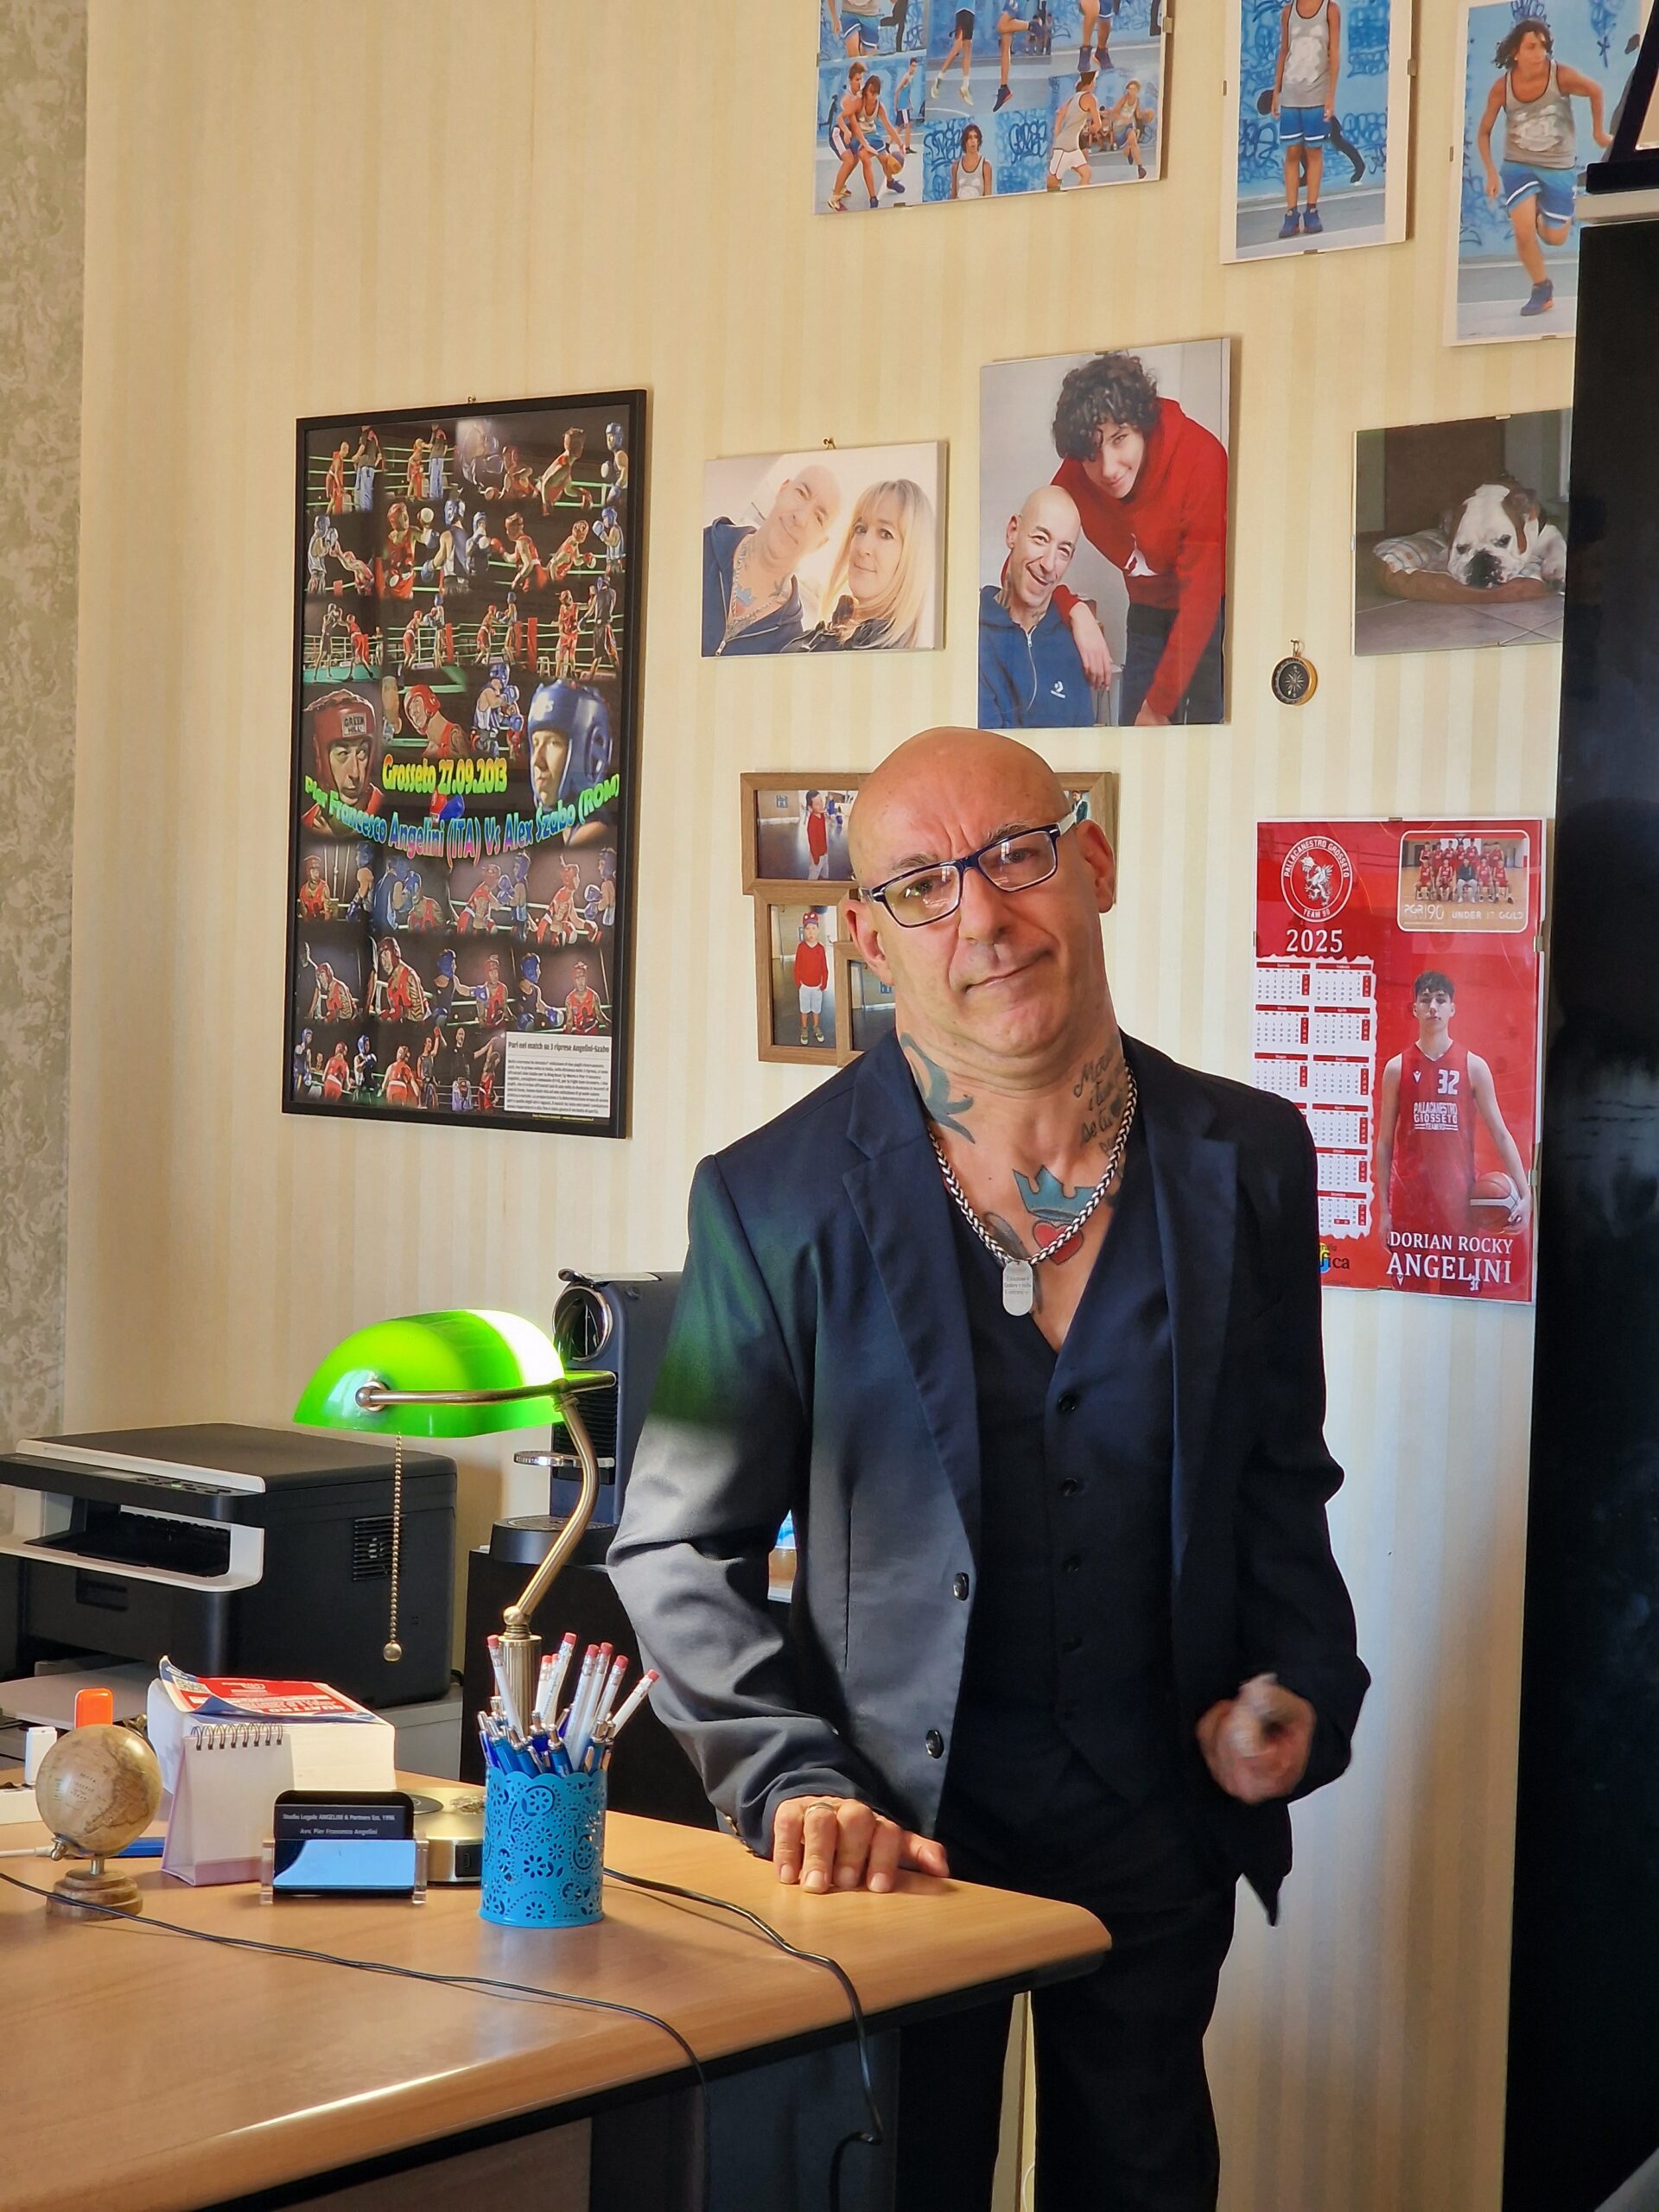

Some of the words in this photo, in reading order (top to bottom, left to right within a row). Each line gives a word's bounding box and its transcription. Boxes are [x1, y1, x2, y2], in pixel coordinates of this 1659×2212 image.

[382, 753, 436, 793] Grosseto
[437, 757, 508, 794] 27.09.2013
[305, 775, 327, 808] Pier
[328, 790, 388, 844] Francesco
[389, 811, 444, 859] Angelini
[446, 816, 481, 870] (ITA)
[484, 817, 501, 856] Vs
[503, 812, 534, 853] Alex
[535, 799, 576, 843] Szabo
[578, 773, 620, 825] (ROM)
[1283, 839, 1327, 878] PALLACANESTRO
[1327, 842, 1350, 878] GROSSETO
[1303, 908, 1321, 918] TEAM
[1322, 908, 1331, 918] 90
[1452, 911, 1482, 920] UNDER
[1498, 911, 1524, 920] GOLD
[1286, 929, 1343, 953] 2025
[1437, 1069, 1460, 1096] 32
[1389, 1231, 1452, 1250] DORIAN
[1458, 1236, 1514, 1255] ROCKY
[1386, 1252, 1512, 1284] ANGELINI
